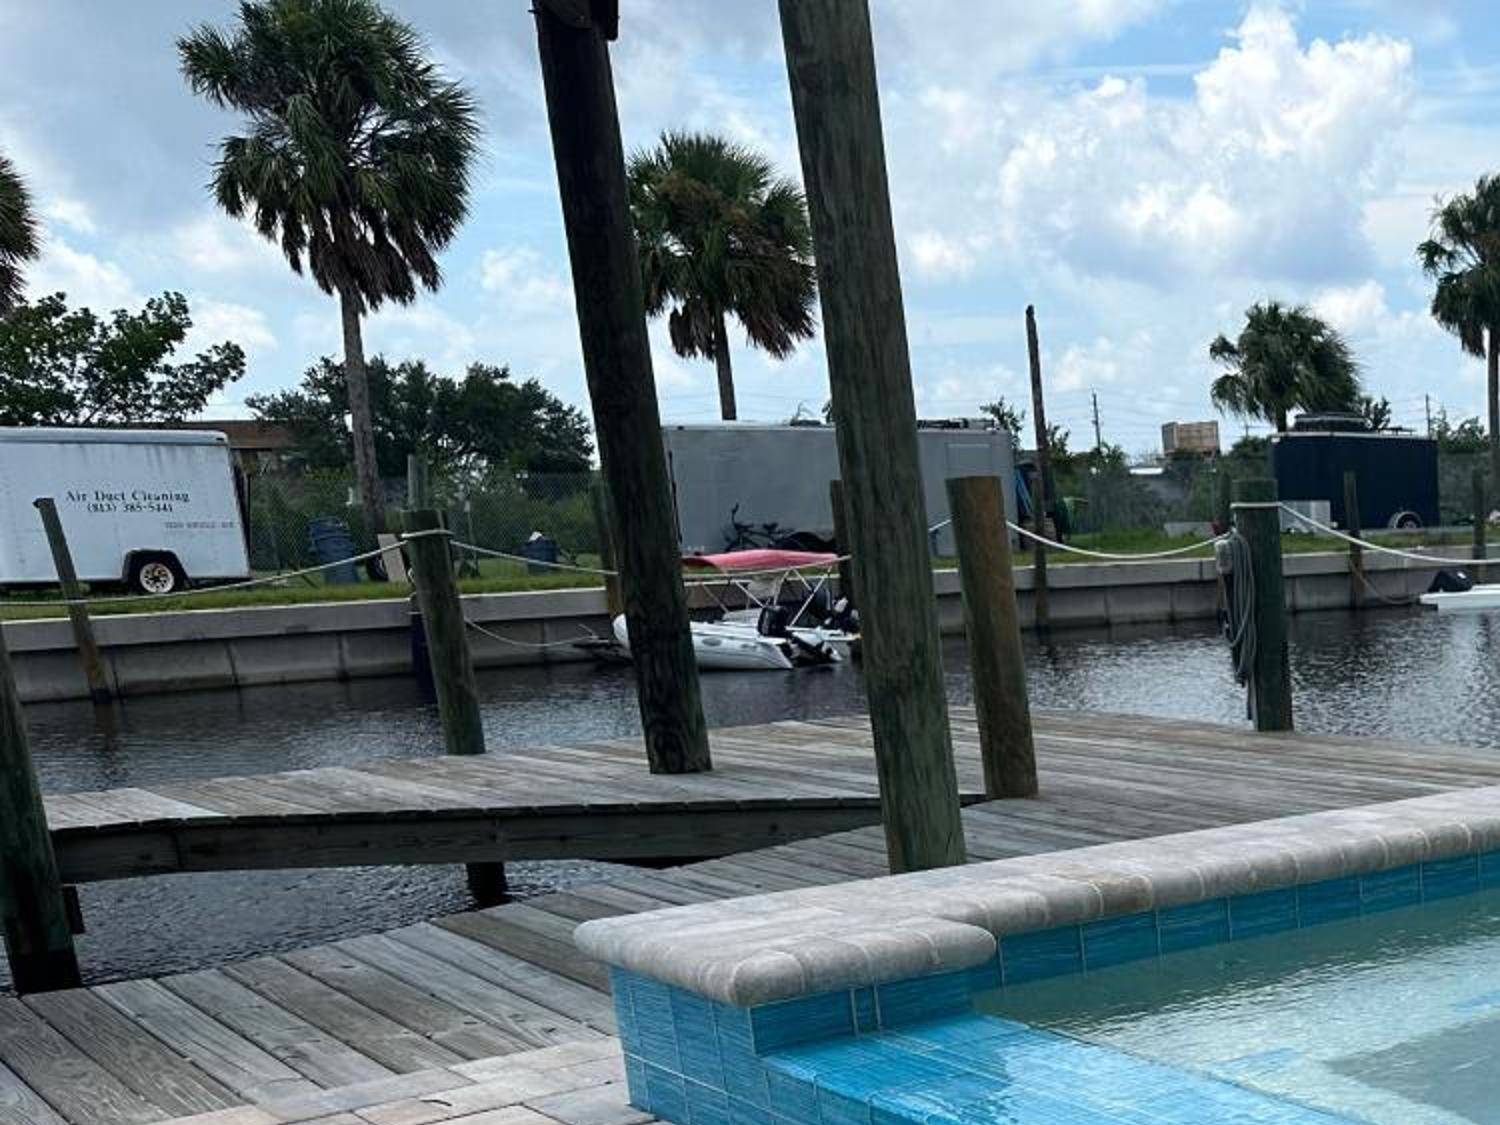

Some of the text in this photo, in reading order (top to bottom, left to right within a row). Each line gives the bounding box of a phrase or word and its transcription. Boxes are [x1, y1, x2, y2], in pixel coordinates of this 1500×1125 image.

[66, 490, 190, 503] Air Duct Cleaning
